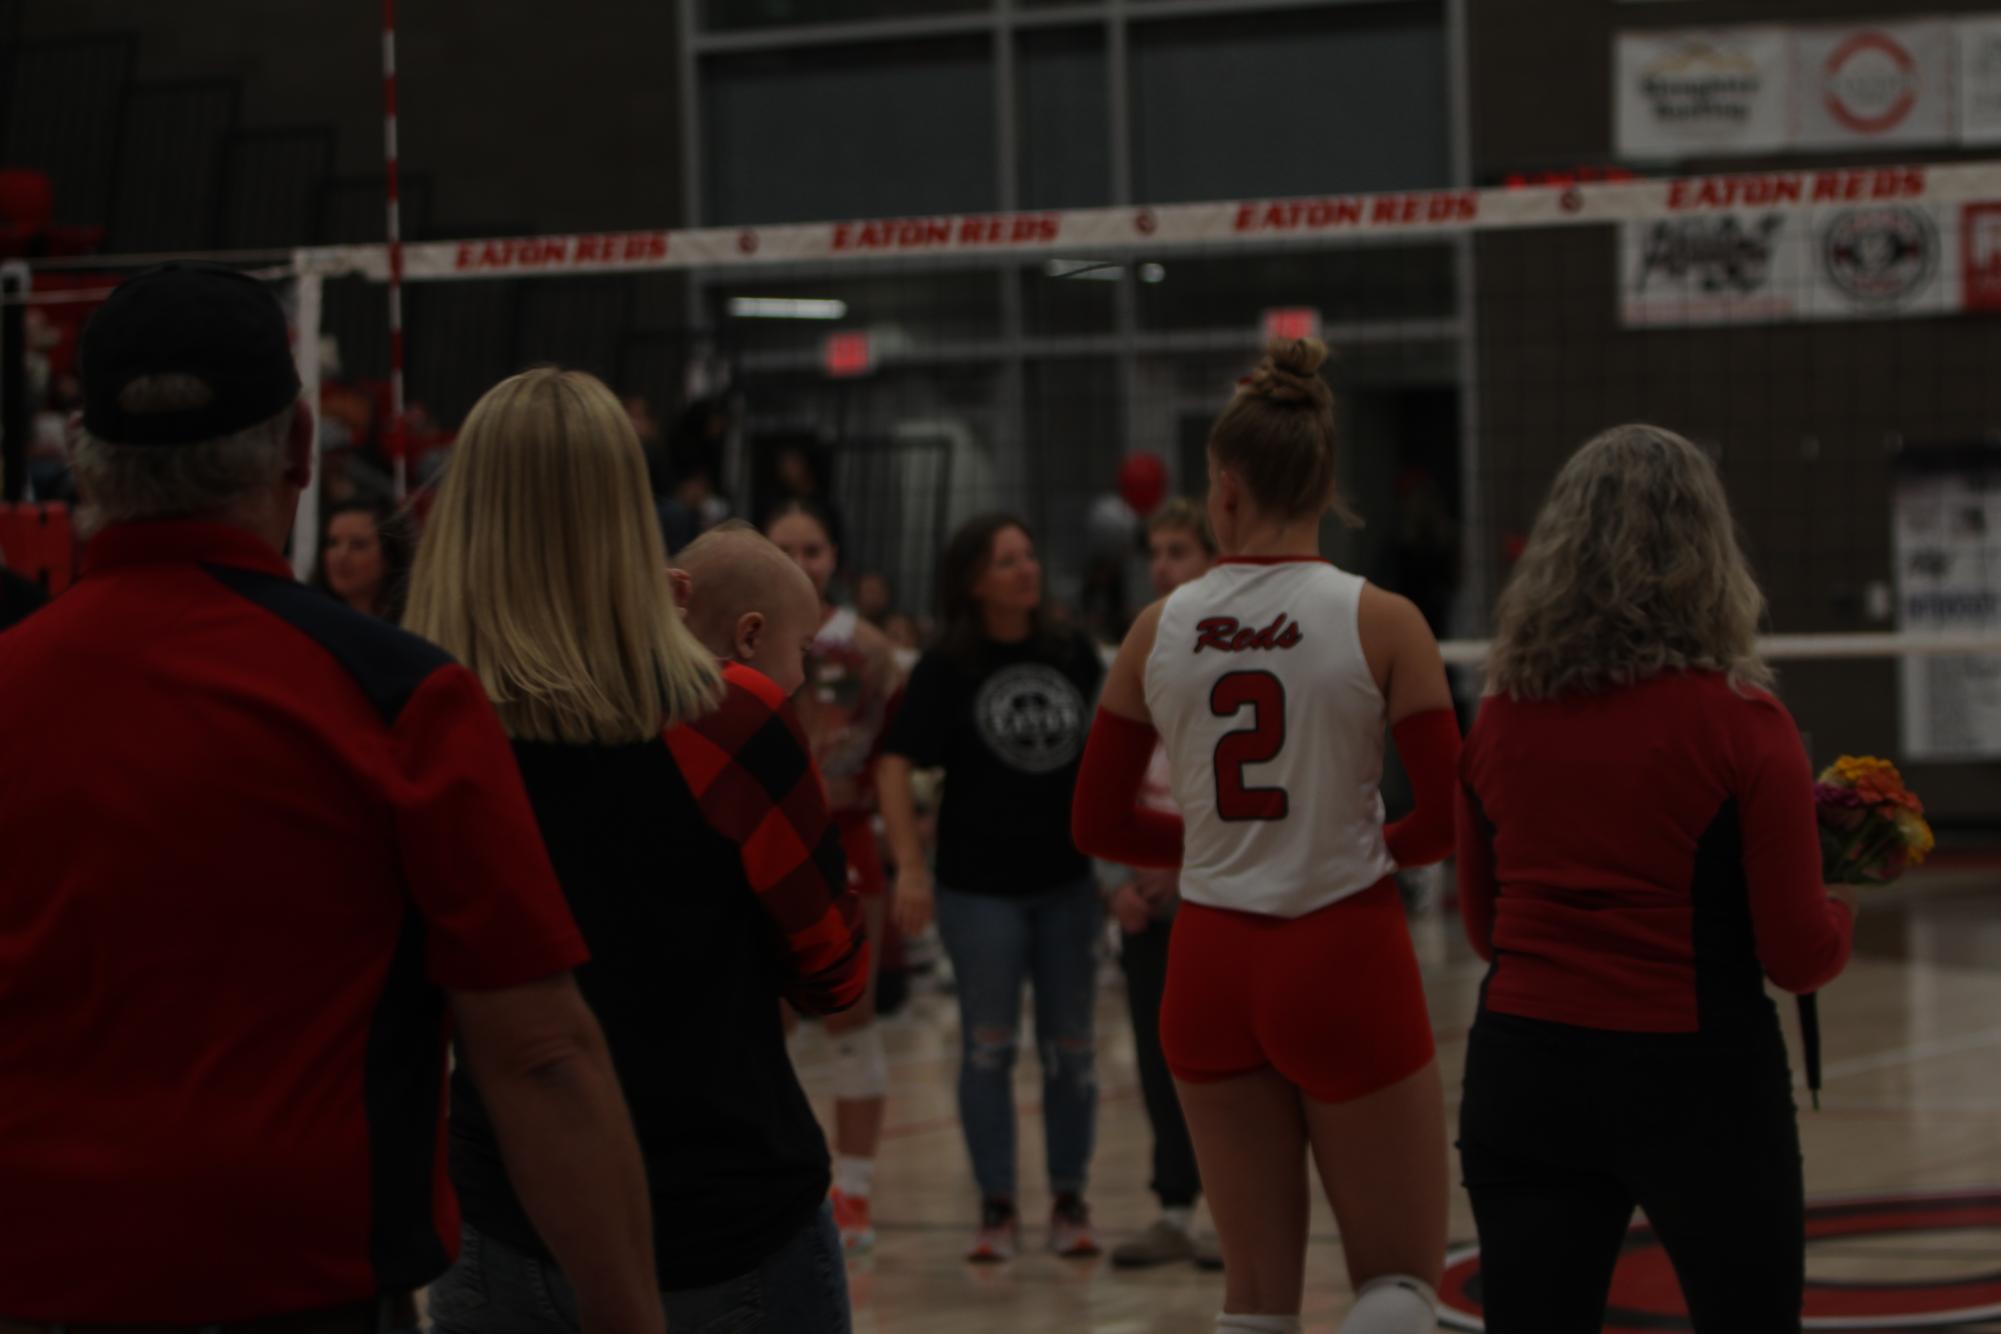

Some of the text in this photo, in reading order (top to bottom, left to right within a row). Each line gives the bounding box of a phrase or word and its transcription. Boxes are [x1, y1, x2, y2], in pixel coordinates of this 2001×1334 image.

[1667, 177, 1801, 210] EATON
[1812, 168, 1925, 201] REDS
[832, 211, 1058, 249] EATON REDS
[1234, 194, 1476, 231] EATON REDS
[456, 233, 667, 268] EATON REDS
[1194, 612, 1303, 653] Reds
[1211, 670, 1289, 822] 2
